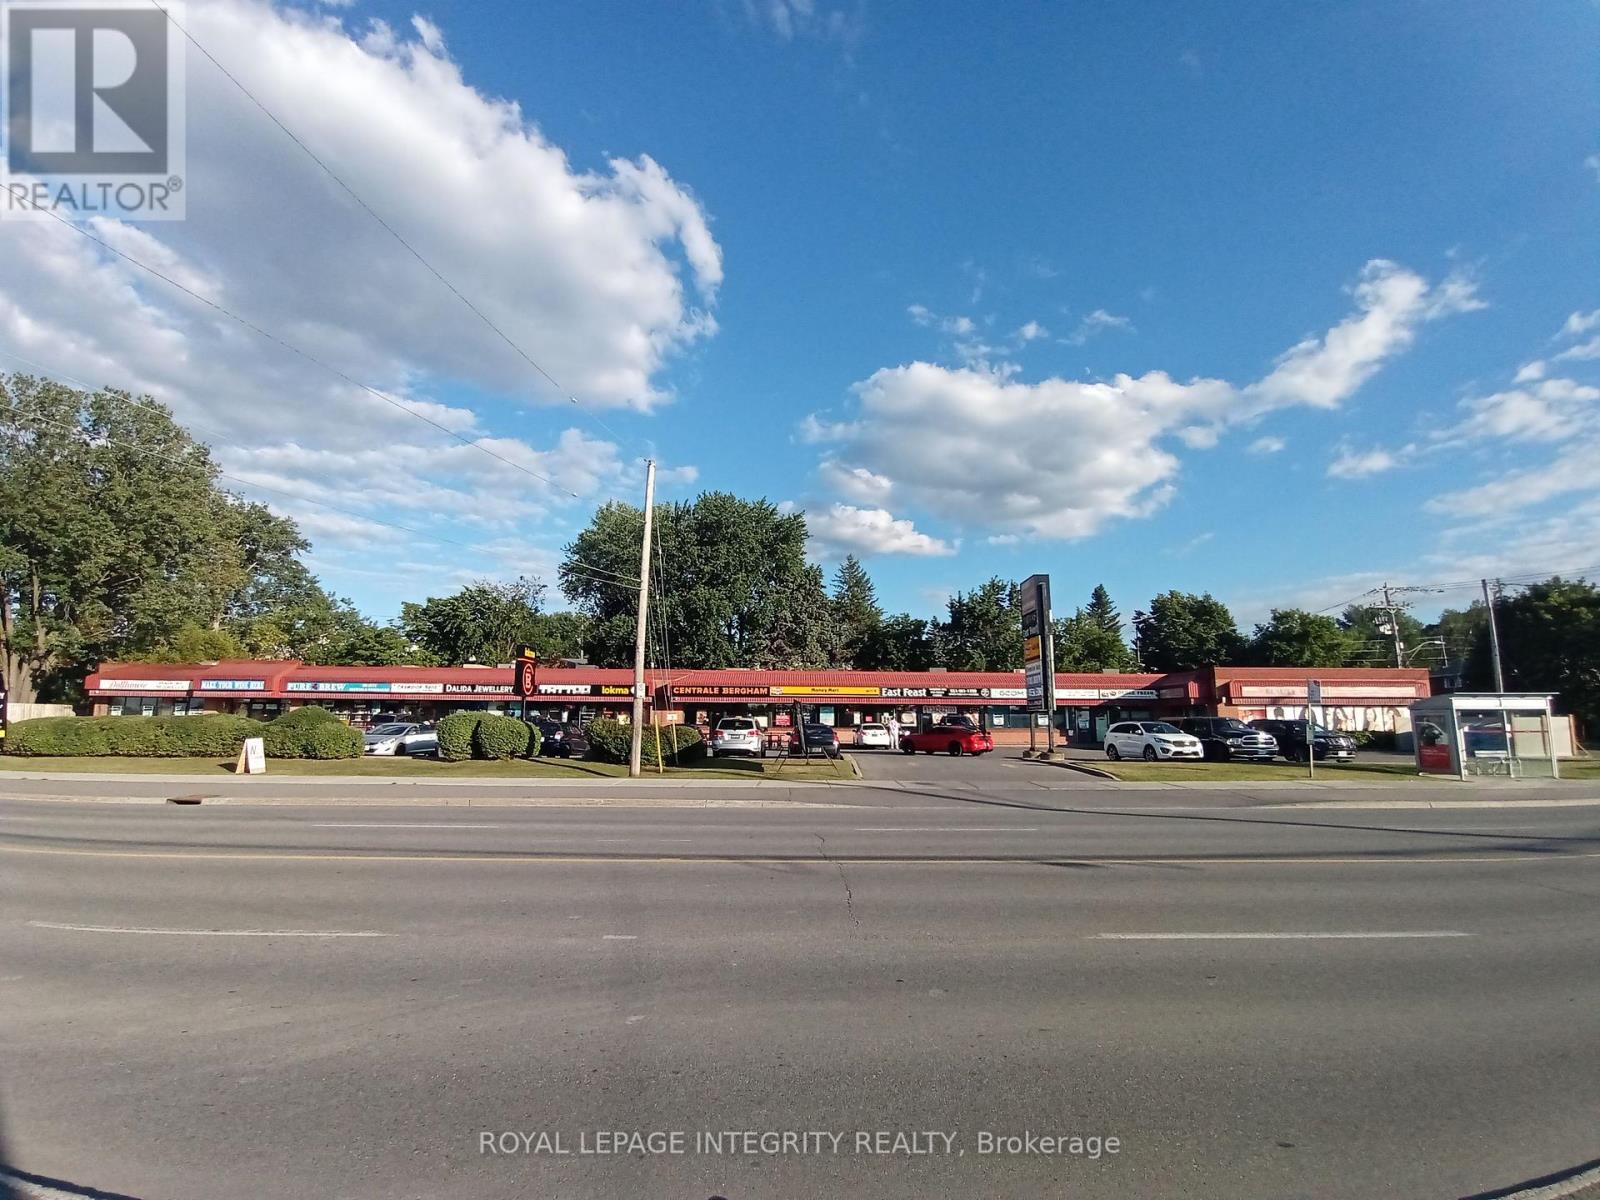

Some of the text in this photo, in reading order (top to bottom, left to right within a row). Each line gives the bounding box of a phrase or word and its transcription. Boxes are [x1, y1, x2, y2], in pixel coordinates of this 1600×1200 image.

[445, 684, 472, 693] DALIDA
[473, 685, 514, 694] JEWELLERY
[601, 685, 629, 694] lokma
[721, 687, 768, 695] BERGHAM
[882, 688, 901, 697] East
[903, 688, 927, 697] Feast
